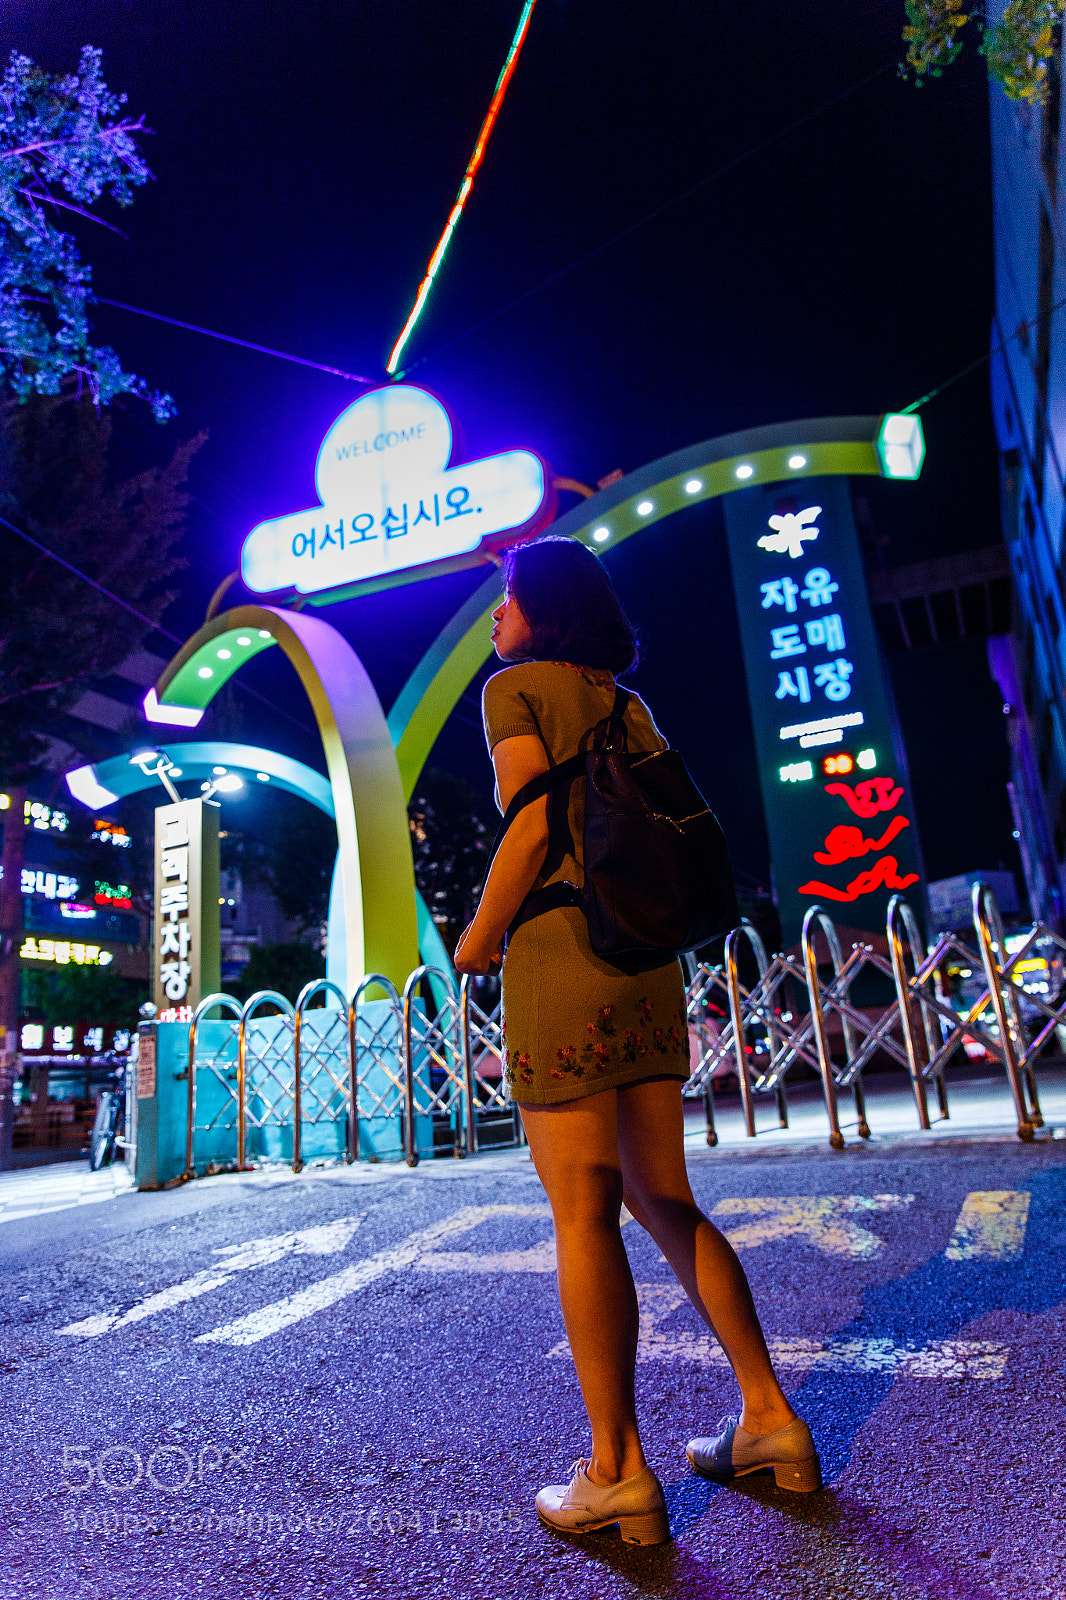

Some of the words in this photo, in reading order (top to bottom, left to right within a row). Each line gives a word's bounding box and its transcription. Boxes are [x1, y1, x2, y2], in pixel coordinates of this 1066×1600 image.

[335, 422, 427, 462] WELCOME
[291, 485, 483, 560] 어서오십시오.
[759, 566, 840, 613] 자유
[769, 612, 847, 660] 도매
[774, 657, 855, 704] 시장
